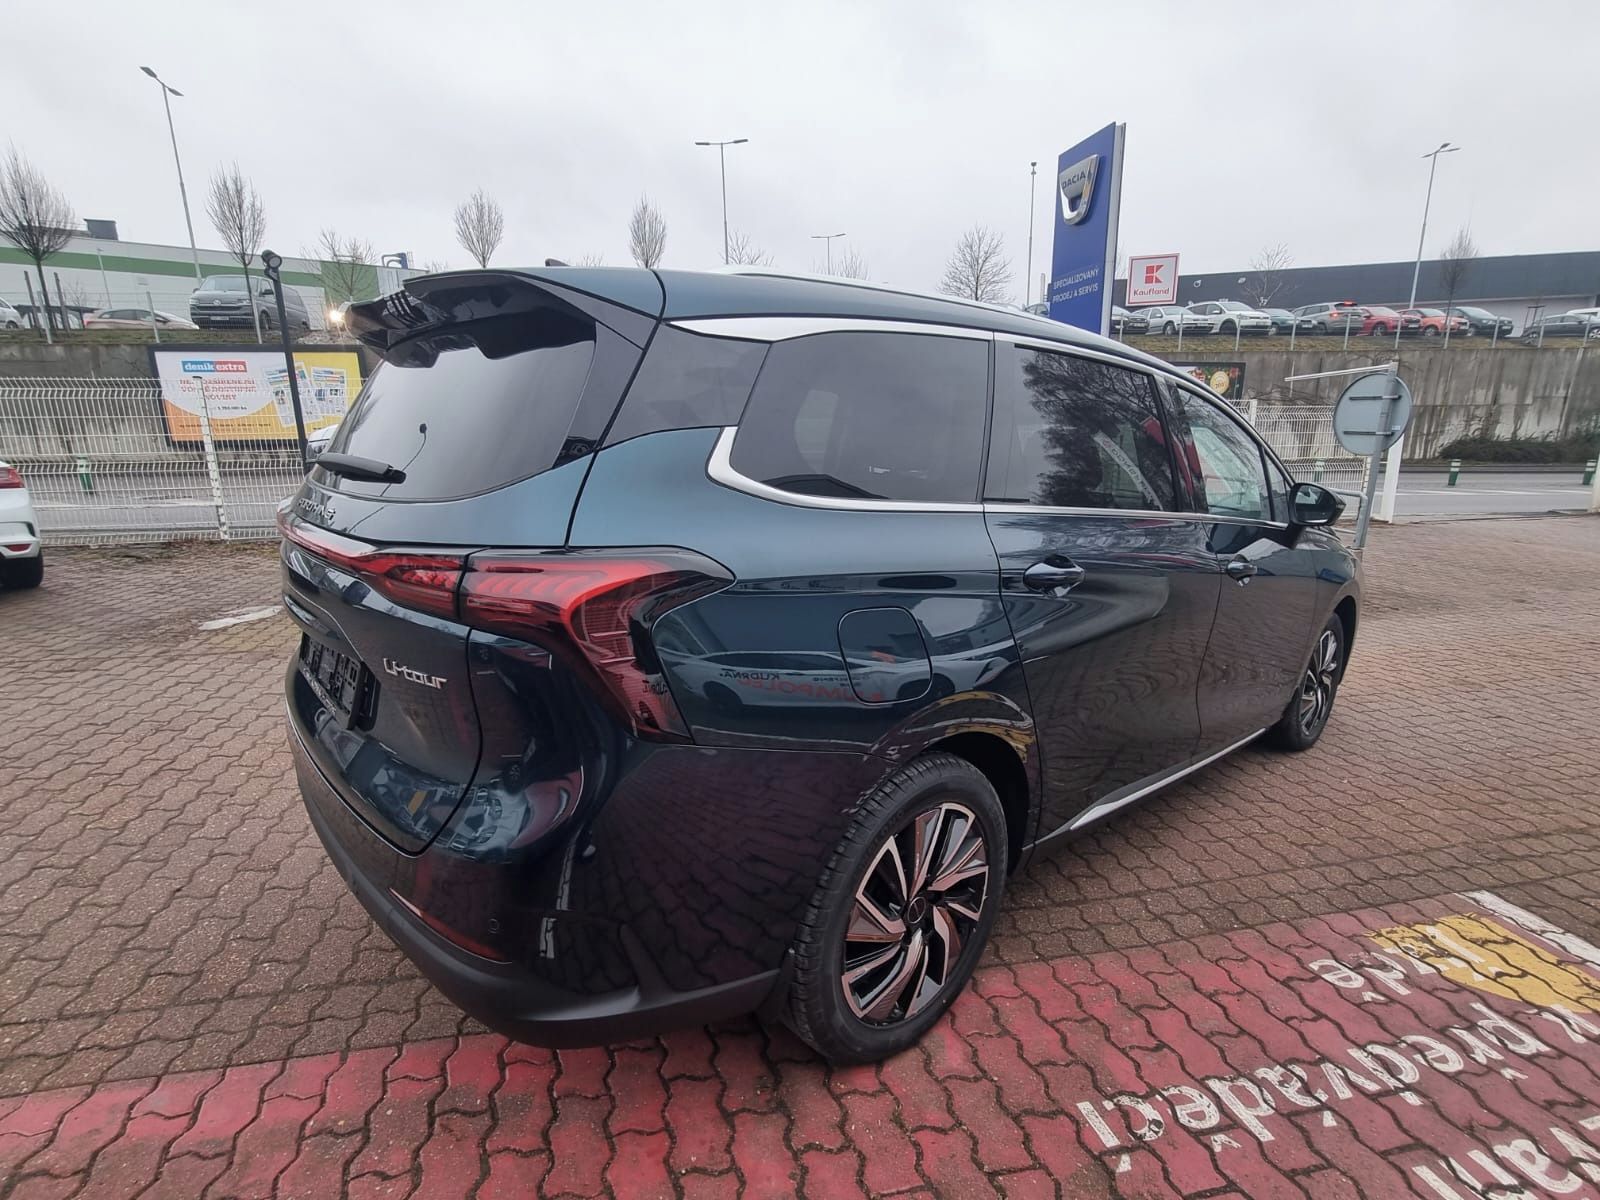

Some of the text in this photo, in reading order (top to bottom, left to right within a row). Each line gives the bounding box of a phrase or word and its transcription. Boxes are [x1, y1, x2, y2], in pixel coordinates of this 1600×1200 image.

[1061, 171, 1086, 190] DACIA
[1052, 290, 1073, 304] PRODEJ
[1078, 282, 1099, 296] SERVIS
[1133, 286, 1170, 298] Kaufland
[215, 362, 246, 371] extra
